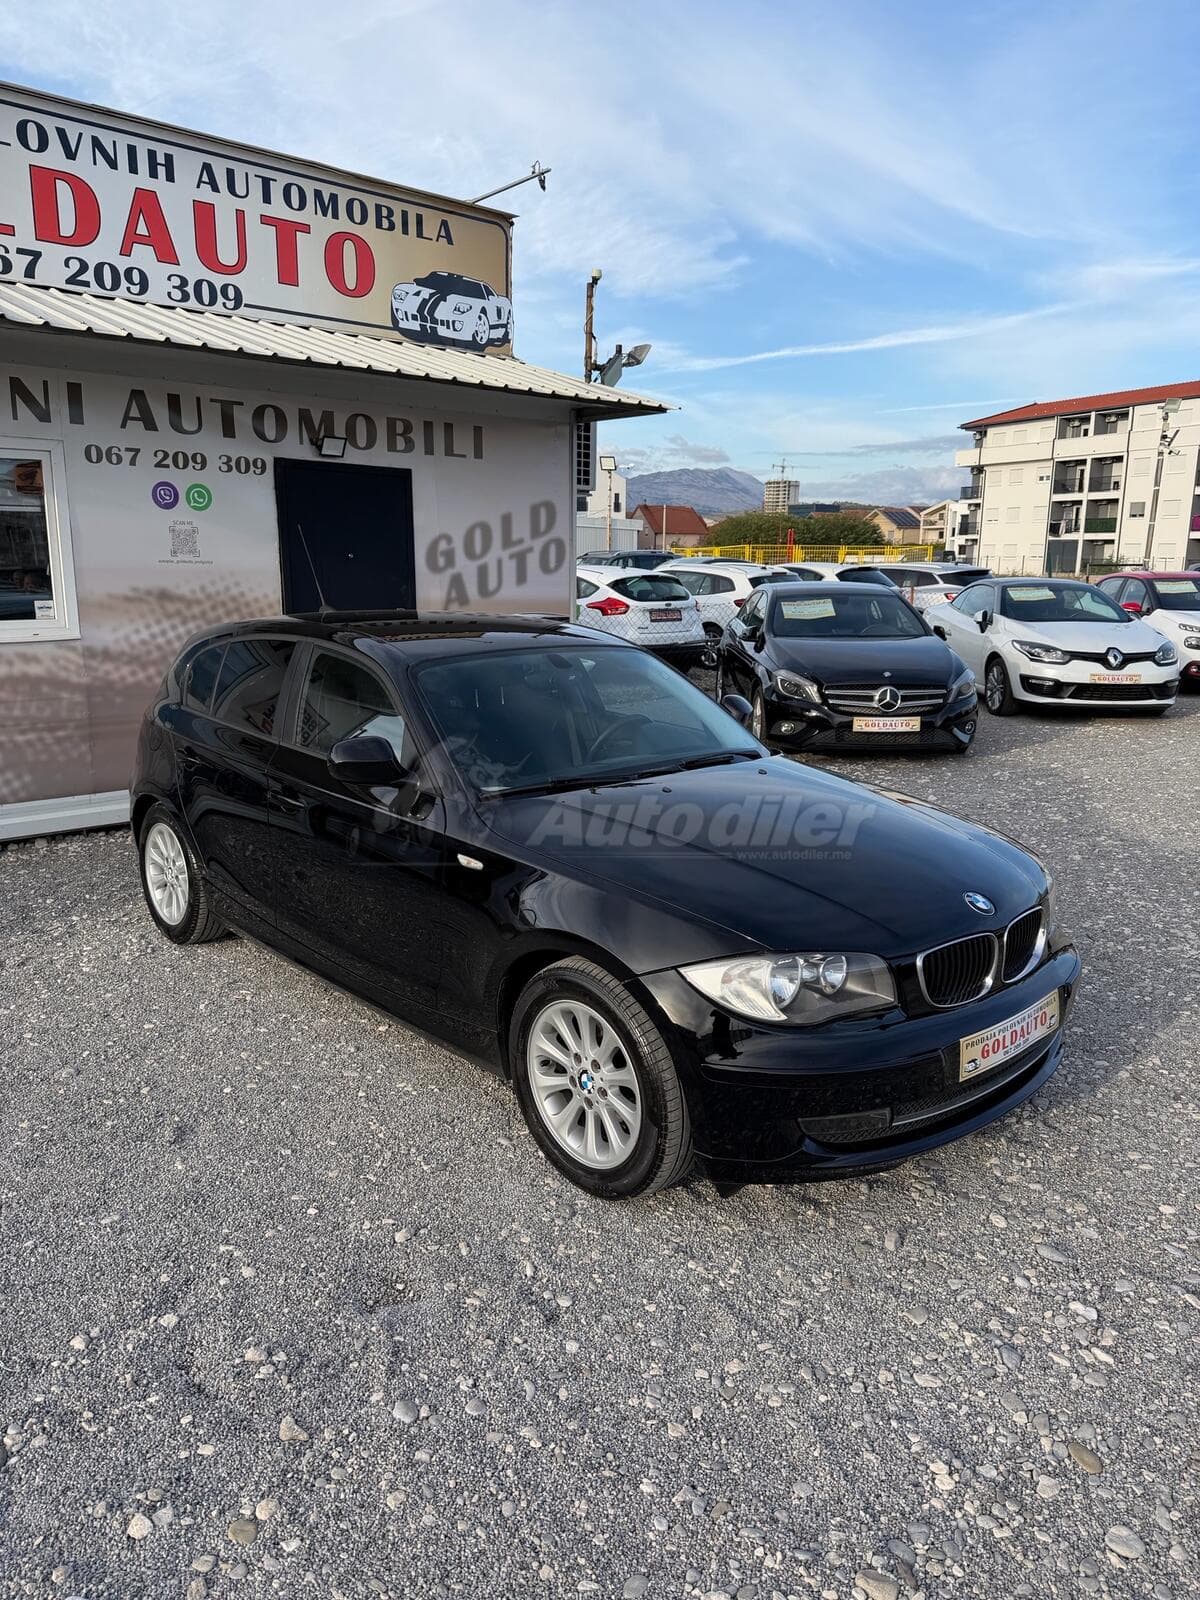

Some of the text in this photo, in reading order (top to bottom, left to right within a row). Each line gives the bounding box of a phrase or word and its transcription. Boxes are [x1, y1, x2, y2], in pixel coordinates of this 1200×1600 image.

[195, 161, 455, 246] AUTOMOBILA
[63, 256, 149, 297] 209
[166, 273, 244, 311] 309
[8, 376, 484, 460] NI AUTOMOBILI
[84, 443, 267, 476] 067 209 309
[424, 499, 557, 574] GOLD
[443, 537, 567, 610] AUTO
[980, 1011, 1047, 1060] GOLDAUTO
